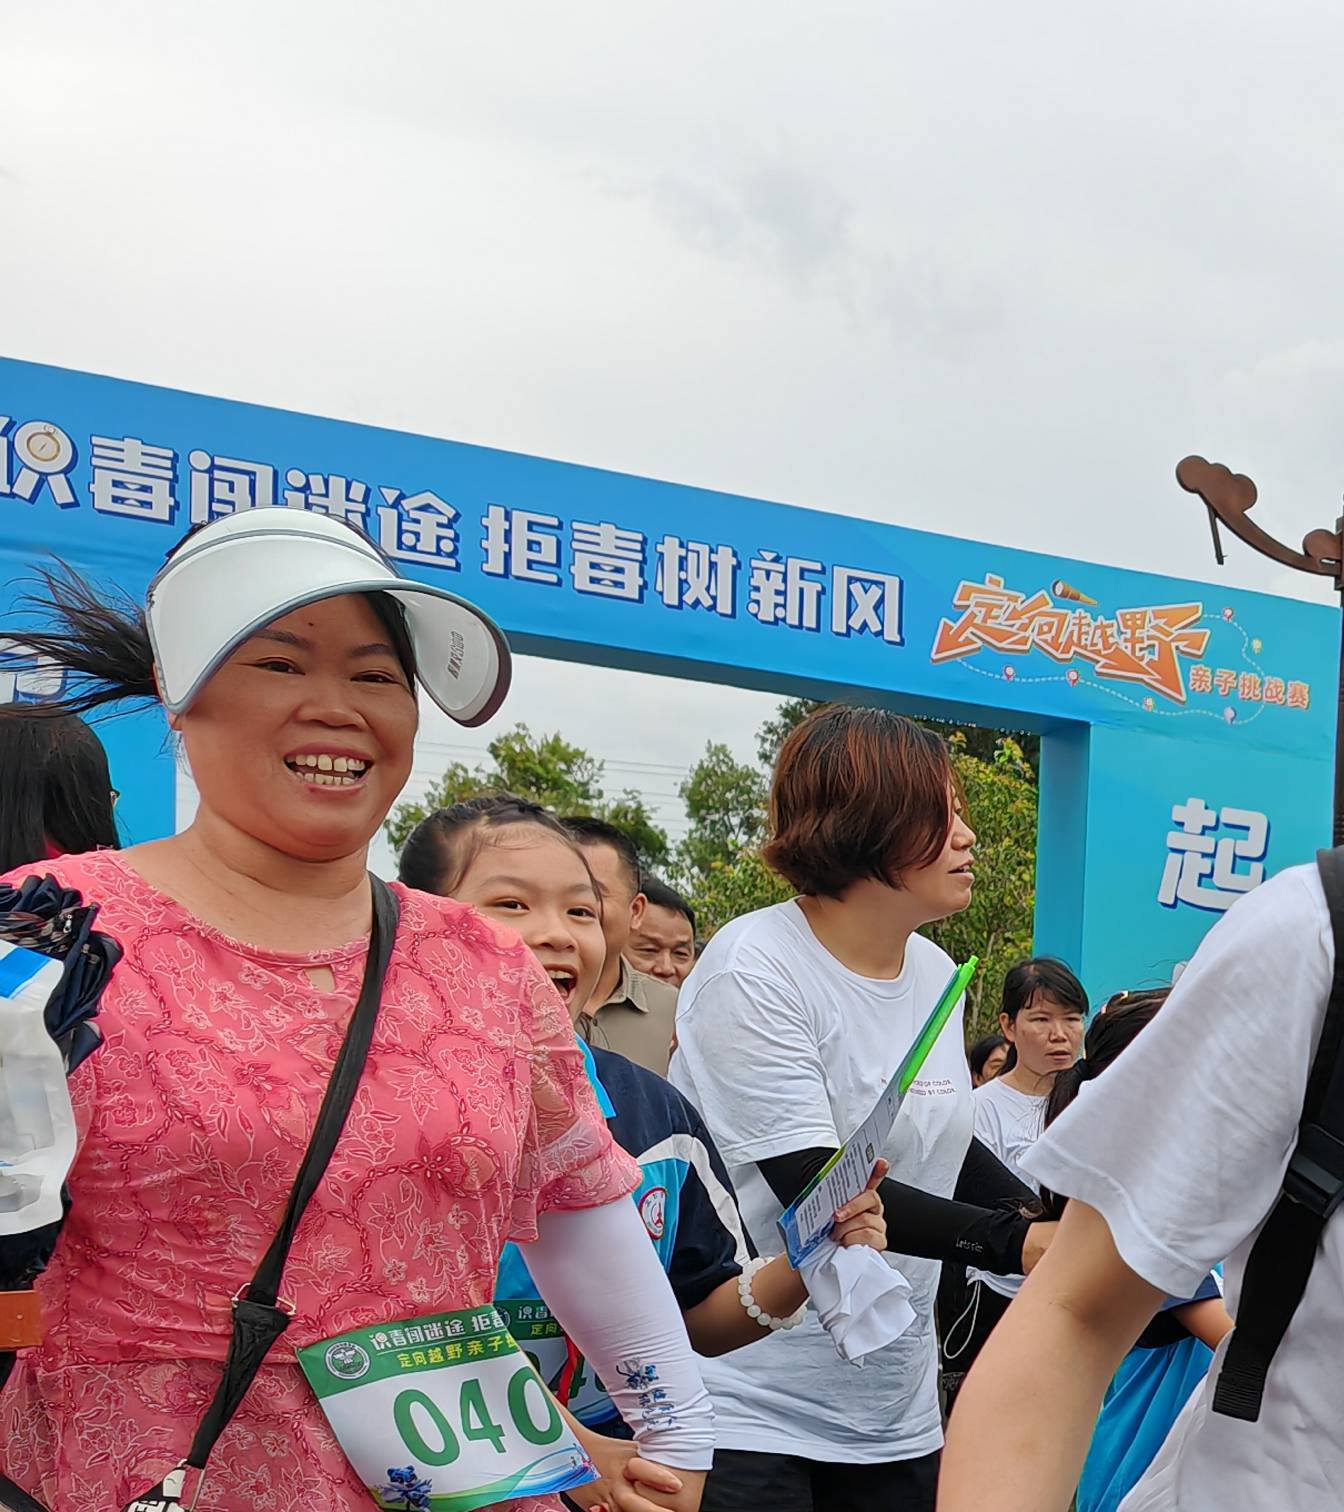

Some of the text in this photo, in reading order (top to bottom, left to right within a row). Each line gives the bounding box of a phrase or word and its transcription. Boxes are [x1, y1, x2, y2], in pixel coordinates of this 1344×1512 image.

[481, 504, 905, 646] 拒毒树新风
[931, 573, 1211, 705] 定向越野
[1189, 665, 1311, 710] 亲子挑战赛
[1158, 798, 1271, 910] 起
[368, 1319, 466, 1350] 识毒闯迷途
[393, 1366, 563, 1467] 040
